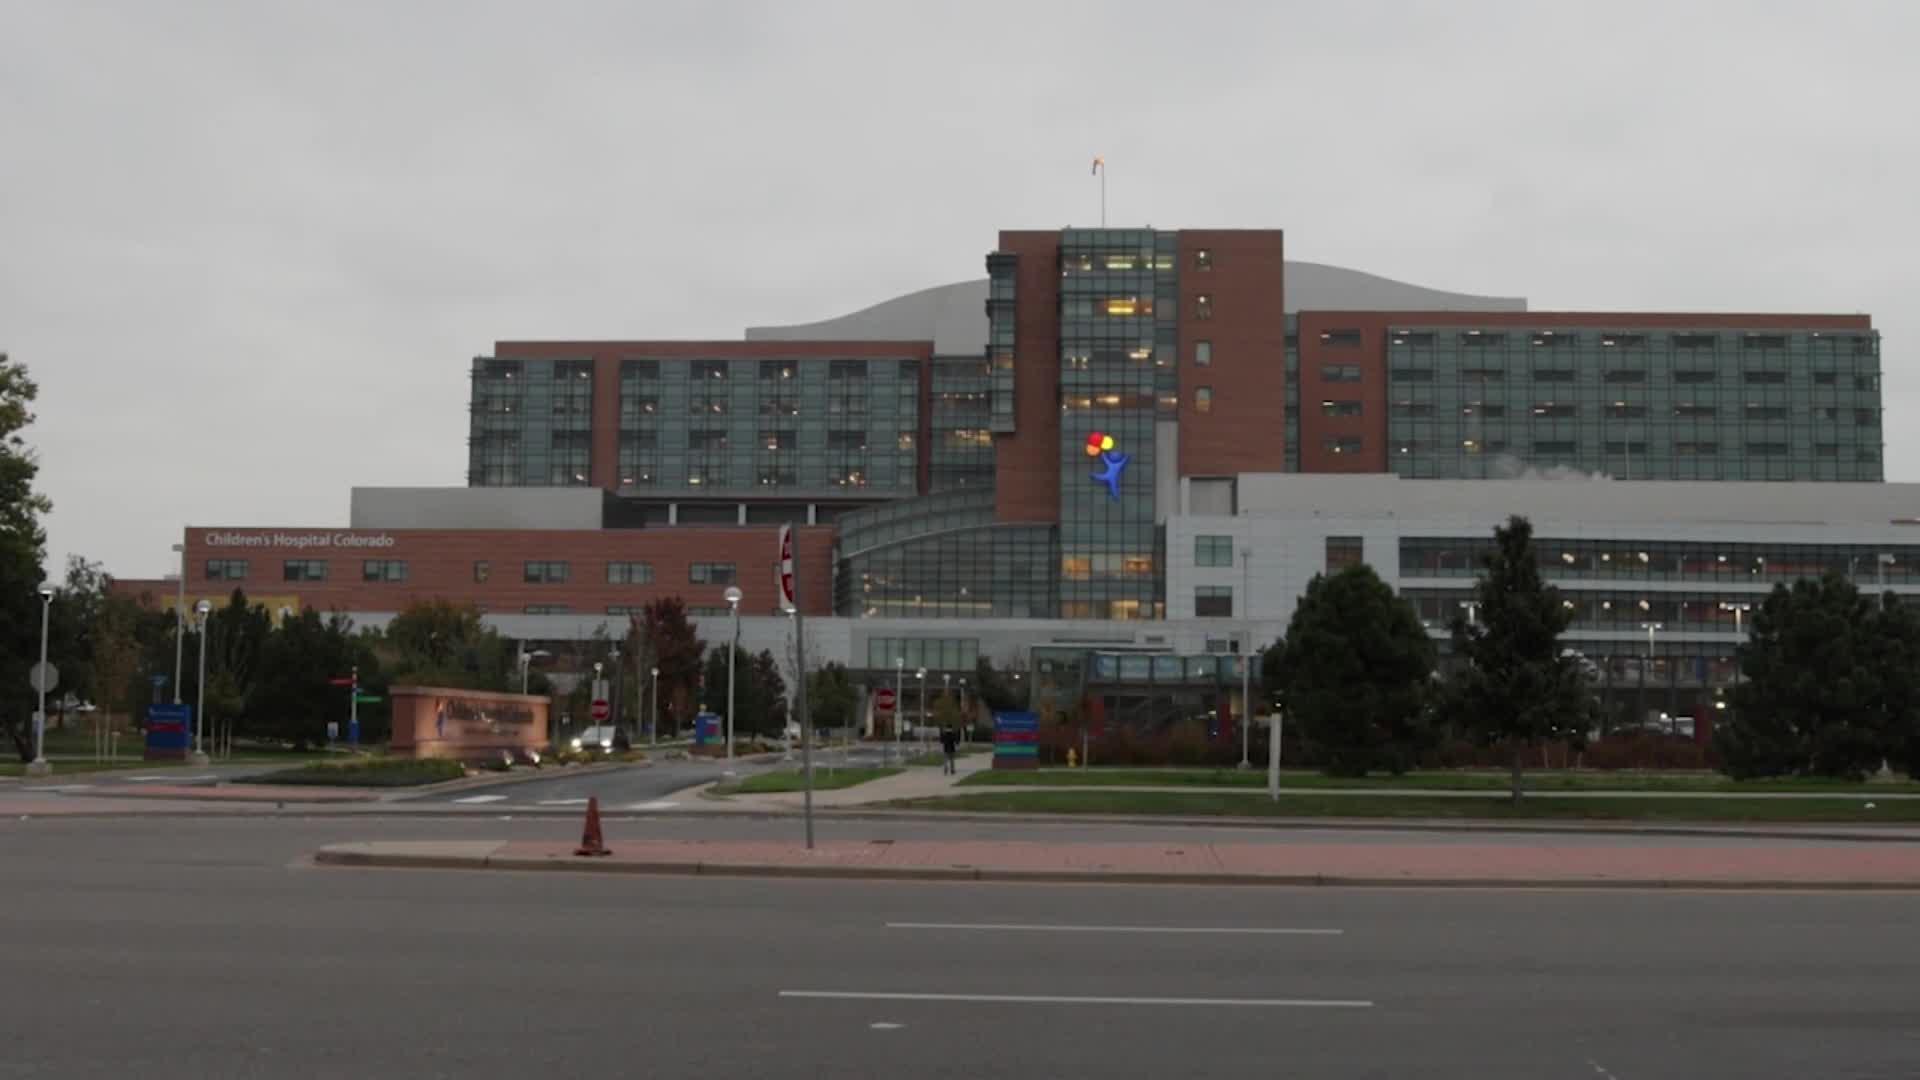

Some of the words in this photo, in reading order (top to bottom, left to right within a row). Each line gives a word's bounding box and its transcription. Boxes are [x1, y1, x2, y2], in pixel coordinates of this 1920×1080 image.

[206, 533, 271, 546] Children's
[274, 533, 330, 548] Hospital
[334, 533, 395, 547] Colorado
